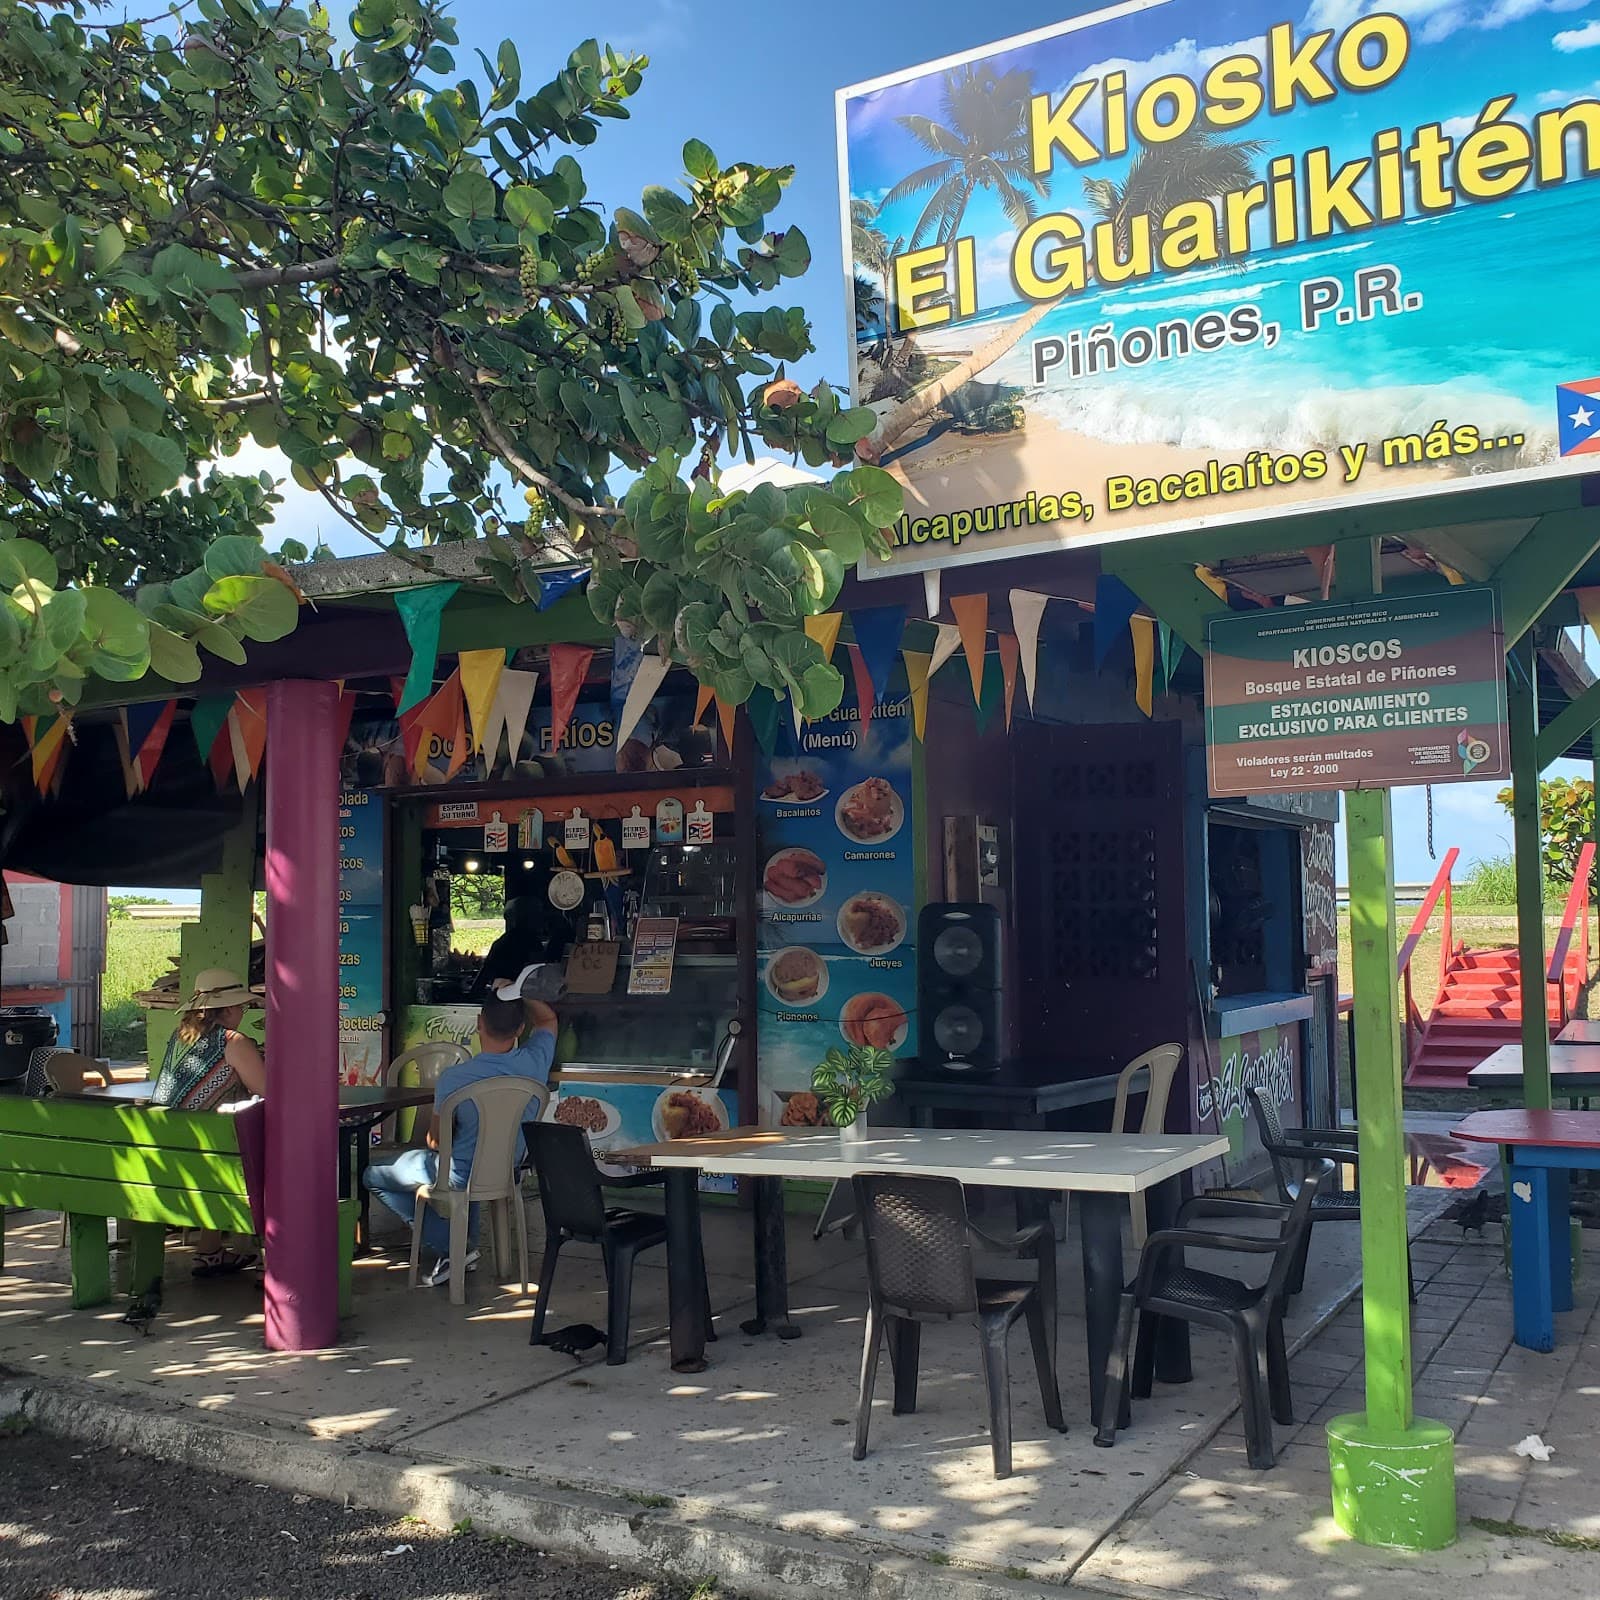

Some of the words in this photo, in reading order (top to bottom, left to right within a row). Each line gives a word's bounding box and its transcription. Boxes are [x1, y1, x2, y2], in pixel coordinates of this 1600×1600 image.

[1029, 13, 1410, 176] Kiosko
[893, 237, 977, 332] El
[1010, 95, 1600, 302] Guarikitén
[1031, 303, 1280, 385] Piñones,
[1300, 266, 1423, 331] P.R.
[1106, 451, 1327, 511] Bacalaítos
[1343, 445, 1367, 481] y
[1382, 422, 1525, 466] más...
[1257, 626, 1305, 637] DEPARTAMENTO
[1306, 624, 1315, 632] DE
[1315, 621, 1349, 630] RECURSOS
[1349, 617, 1387, 626] NATURALES
[1394, 610, 1439, 621] AMBIENTALES
[1304, 616, 1336, 625] GOBIERNO
[1346, 612, 1371, 620] PUERTO
[1372, 610, 1388, 618] RICO
[1293, 638, 1402, 669] KIOSCOS
[1245, 679, 1301, 695] Bosque
[1306, 671, 1361, 688] Estatal
[1366, 669, 1386, 683] de
[1391, 664, 1457, 681] Piñones
[1271, 691, 1430, 719] ESTACIONAMIENTO
[1238, 718, 1329, 739] EXCLUSIVO
[1334, 715, 1378, 731] PARA
[1382, 706, 1468, 727] CLIENTES
[802, 731, 857, 752] (Menú)
[1236, 757, 1290, 767] Violadores
[1293, 752, 1322, 763] serán
[1324, 748, 1374, 760] multados
[1270, 768, 1288, 778] Ley
[1291, 766, 1304, 776] 22
[1313, 764, 1338, 774] 2000
[442, 803, 474, 812] ESPERAR
[452, 810, 476, 819] TURNO
[844, 852, 895, 861] Camarones
[772, 912, 821, 922] Alcapurrias
[870, 959, 902, 969] Jueyes
